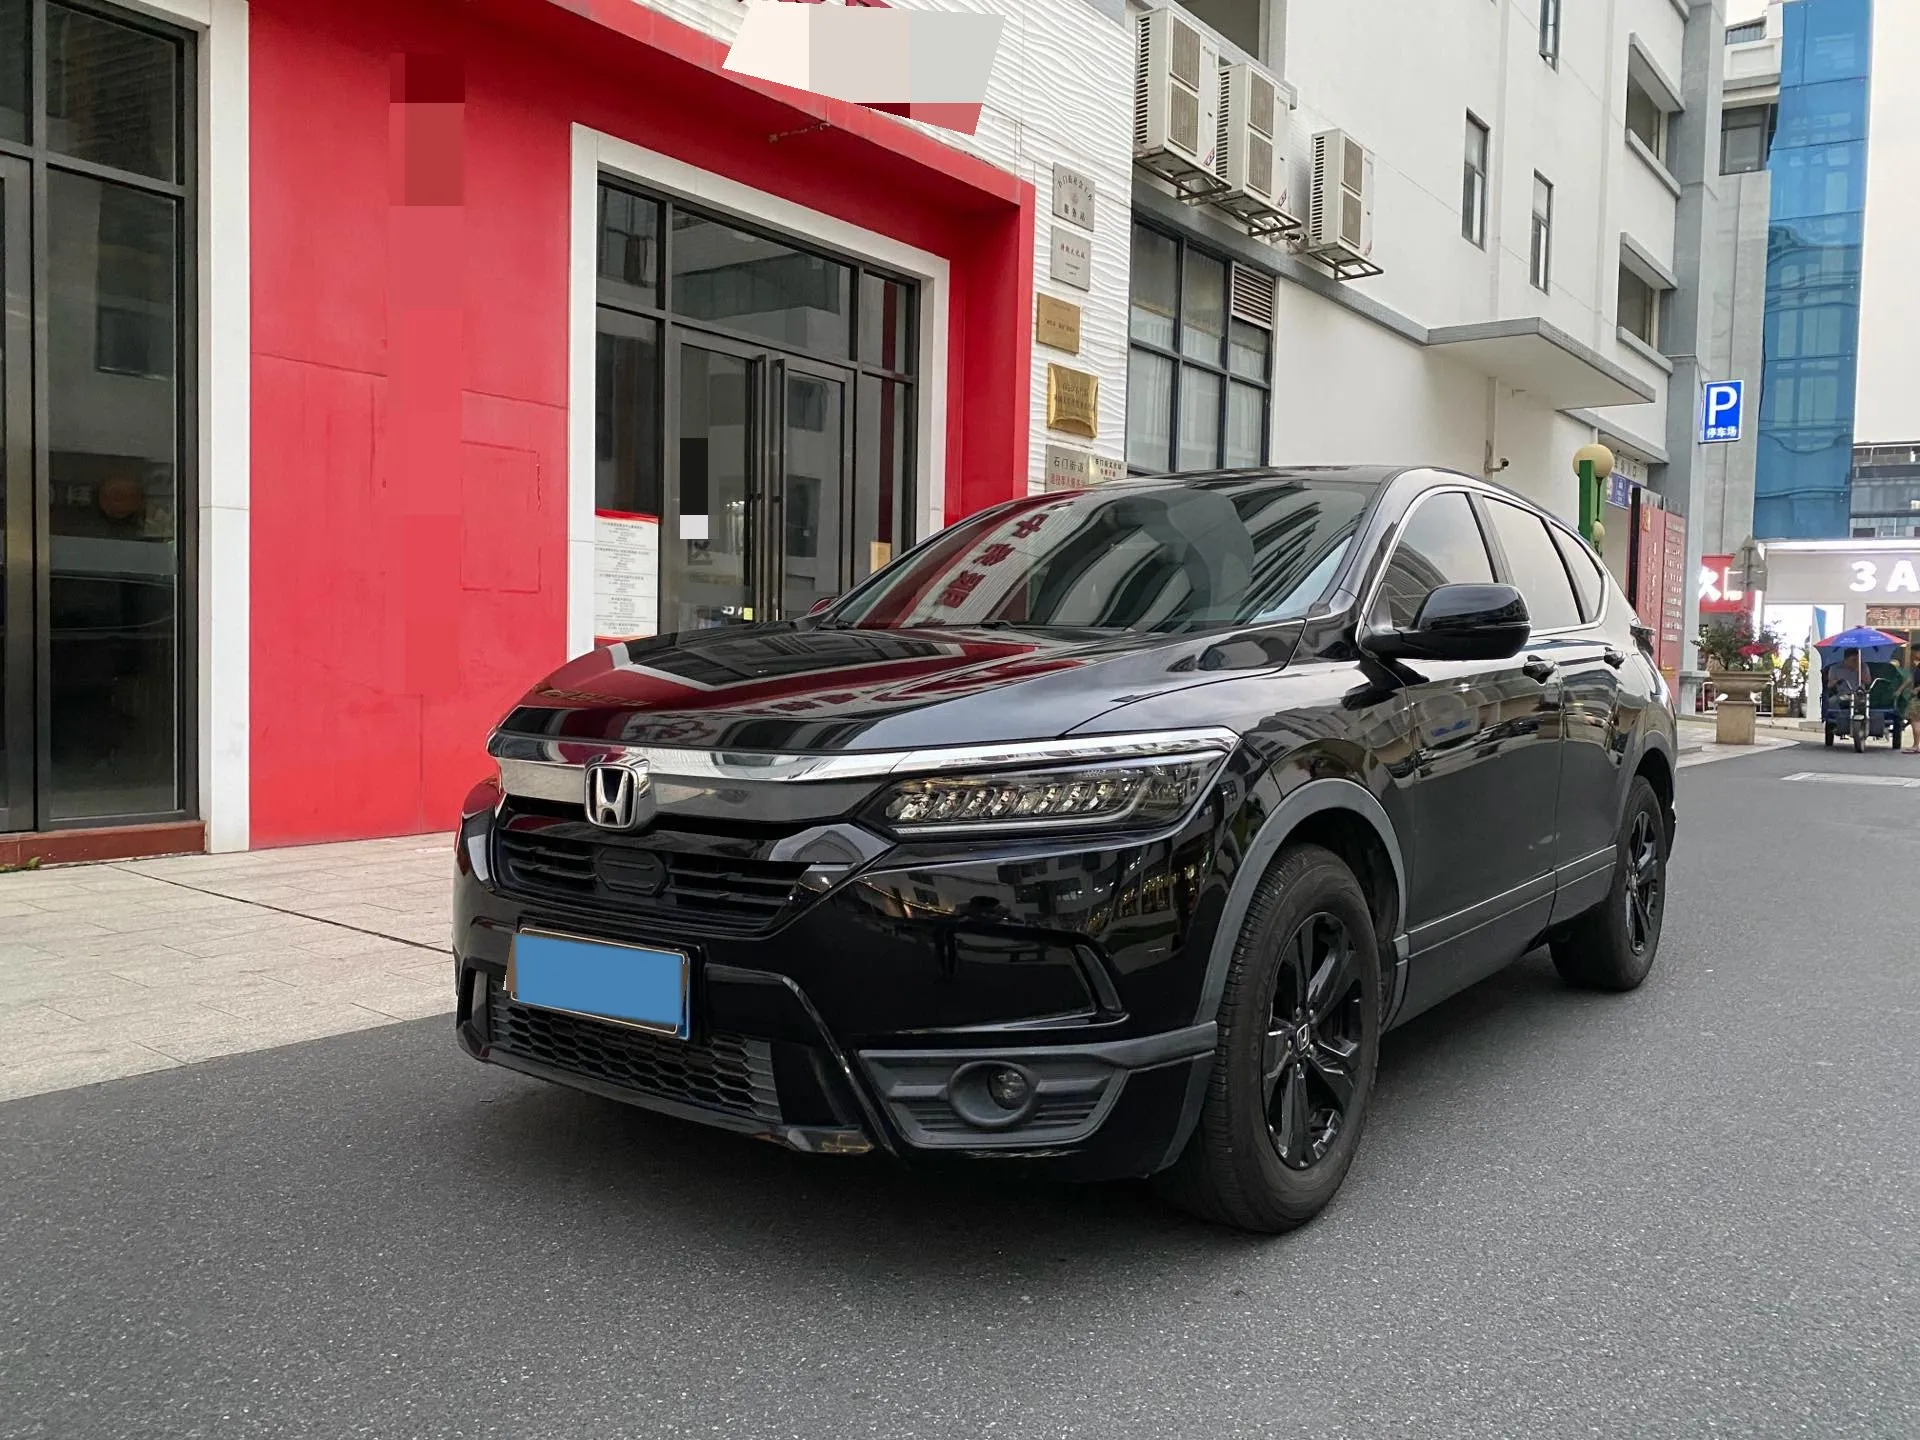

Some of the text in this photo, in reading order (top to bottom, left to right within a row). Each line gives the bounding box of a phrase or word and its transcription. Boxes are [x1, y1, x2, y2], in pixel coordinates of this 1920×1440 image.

[1709, 386, 1737, 426] P
[1707, 426, 1737, 438] 停车场
